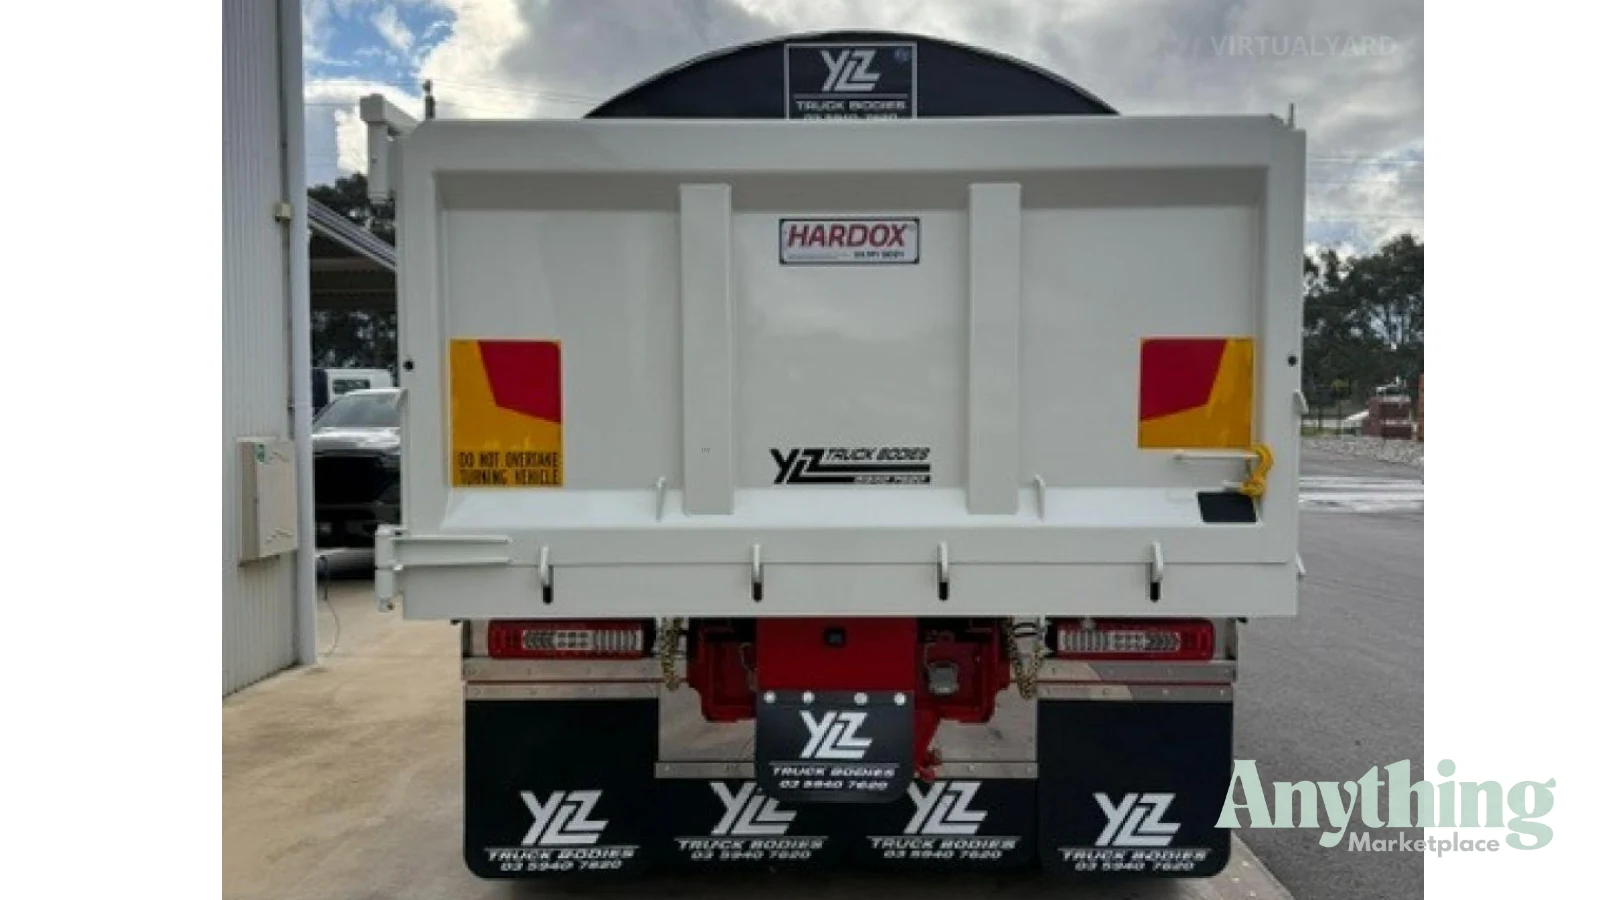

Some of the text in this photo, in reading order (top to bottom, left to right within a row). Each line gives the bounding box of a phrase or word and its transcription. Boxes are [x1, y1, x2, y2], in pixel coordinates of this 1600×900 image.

[796, 101, 905, 110] TRUCK BODIES
[788, 224, 907, 247] HARDOX
[824, 448, 877, 460] TRUCK
[877, 448, 930, 460] BODIES
[459, 452, 559, 468] DO NOT OVERTAKE
[460, 469, 559, 485] TURNING VEHICLE
[773, 767, 895, 776] TRUCK BODIES
[678, 839, 824, 850] TRUCK BODIES
[871, 838, 1016, 849] TRUCK BODIES
[489, 848, 635, 861] TRUCK BODIES
[690, 850, 812, 861] 03 5940 7620
[883, 850, 905, 859] 03
[959, 850, 1003, 860] 7620
[1062, 850, 1206, 861] TRUCK BODIES
[500, 862, 523, 872] 03
